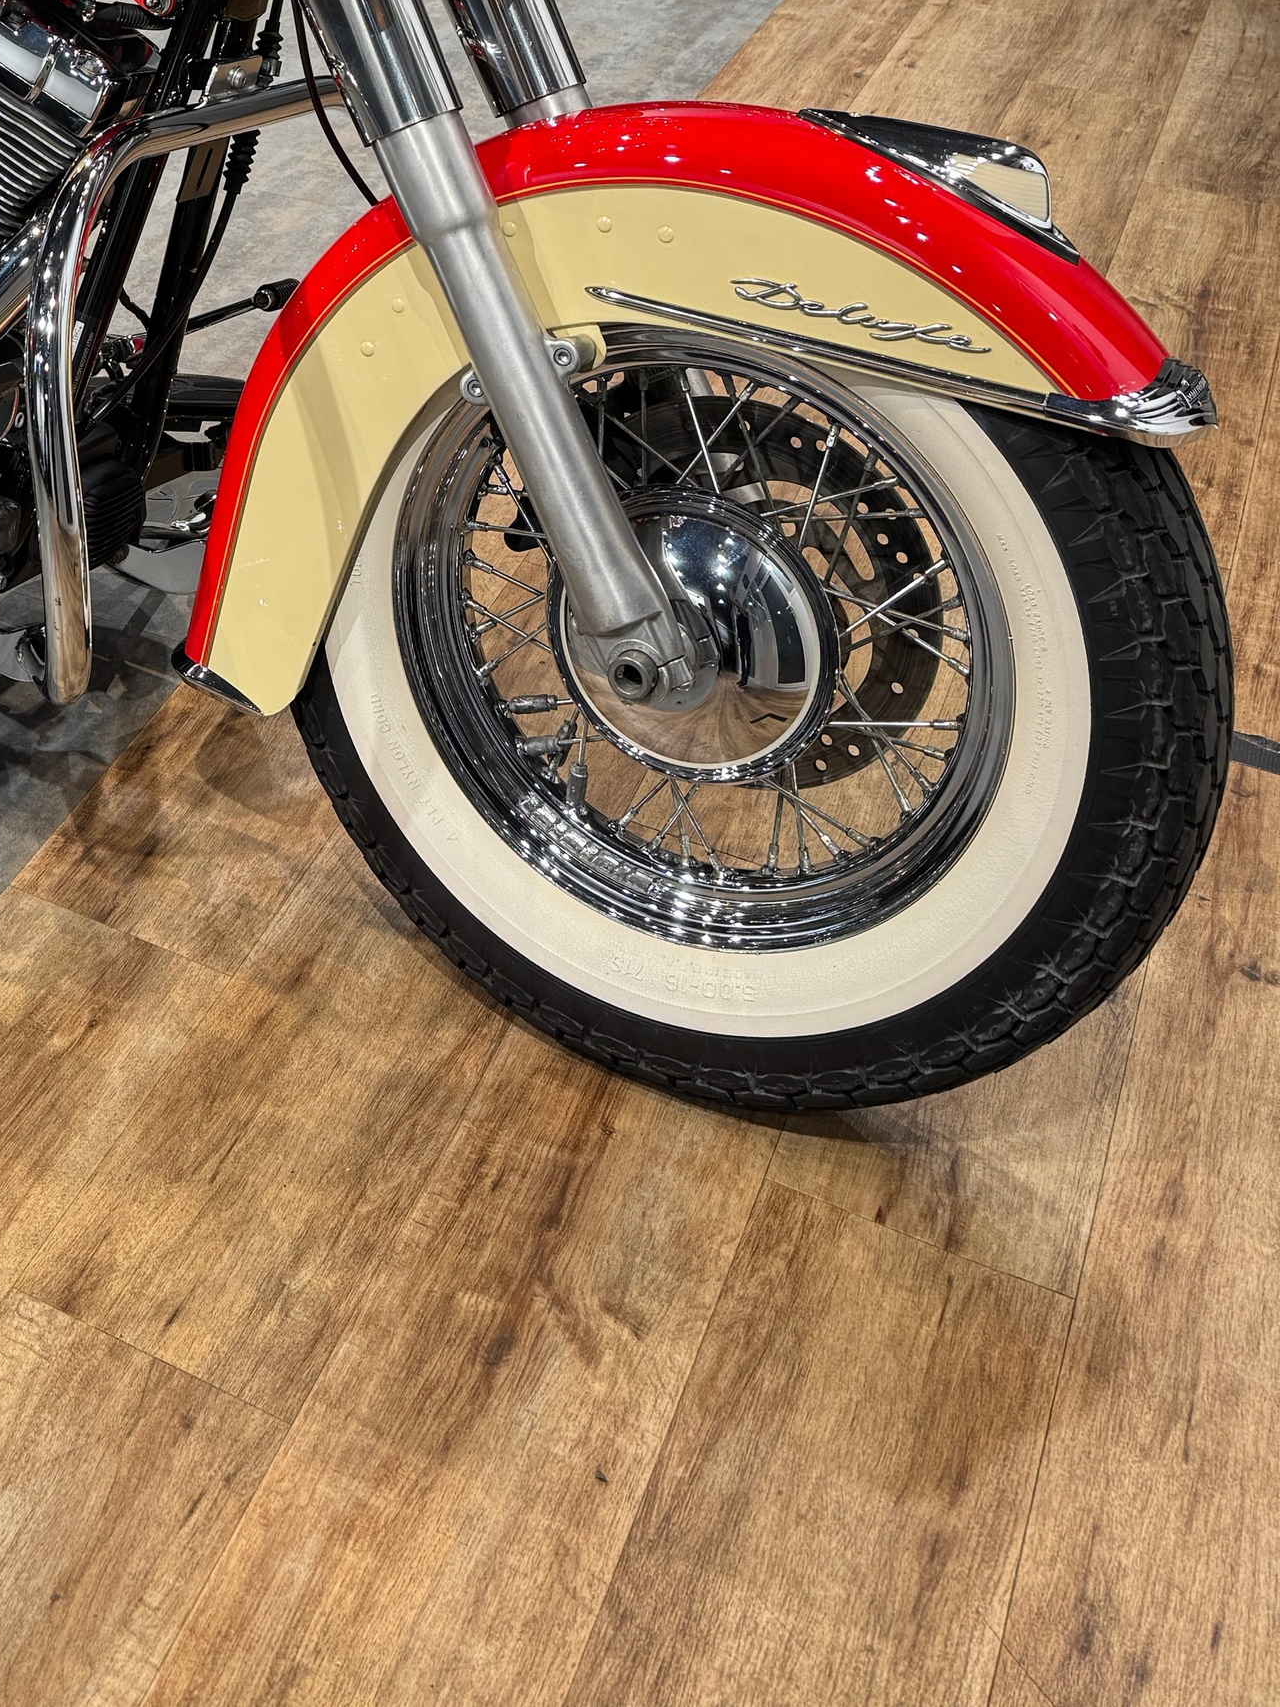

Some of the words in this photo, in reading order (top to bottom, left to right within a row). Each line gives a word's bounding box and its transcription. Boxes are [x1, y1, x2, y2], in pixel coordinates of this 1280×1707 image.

[729, 277, 992, 354] Deluxe
[369, 693, 391, 735] CORD
[386, 738, 421, 791] NYLON
[417, 796, 445, 826] PLY
